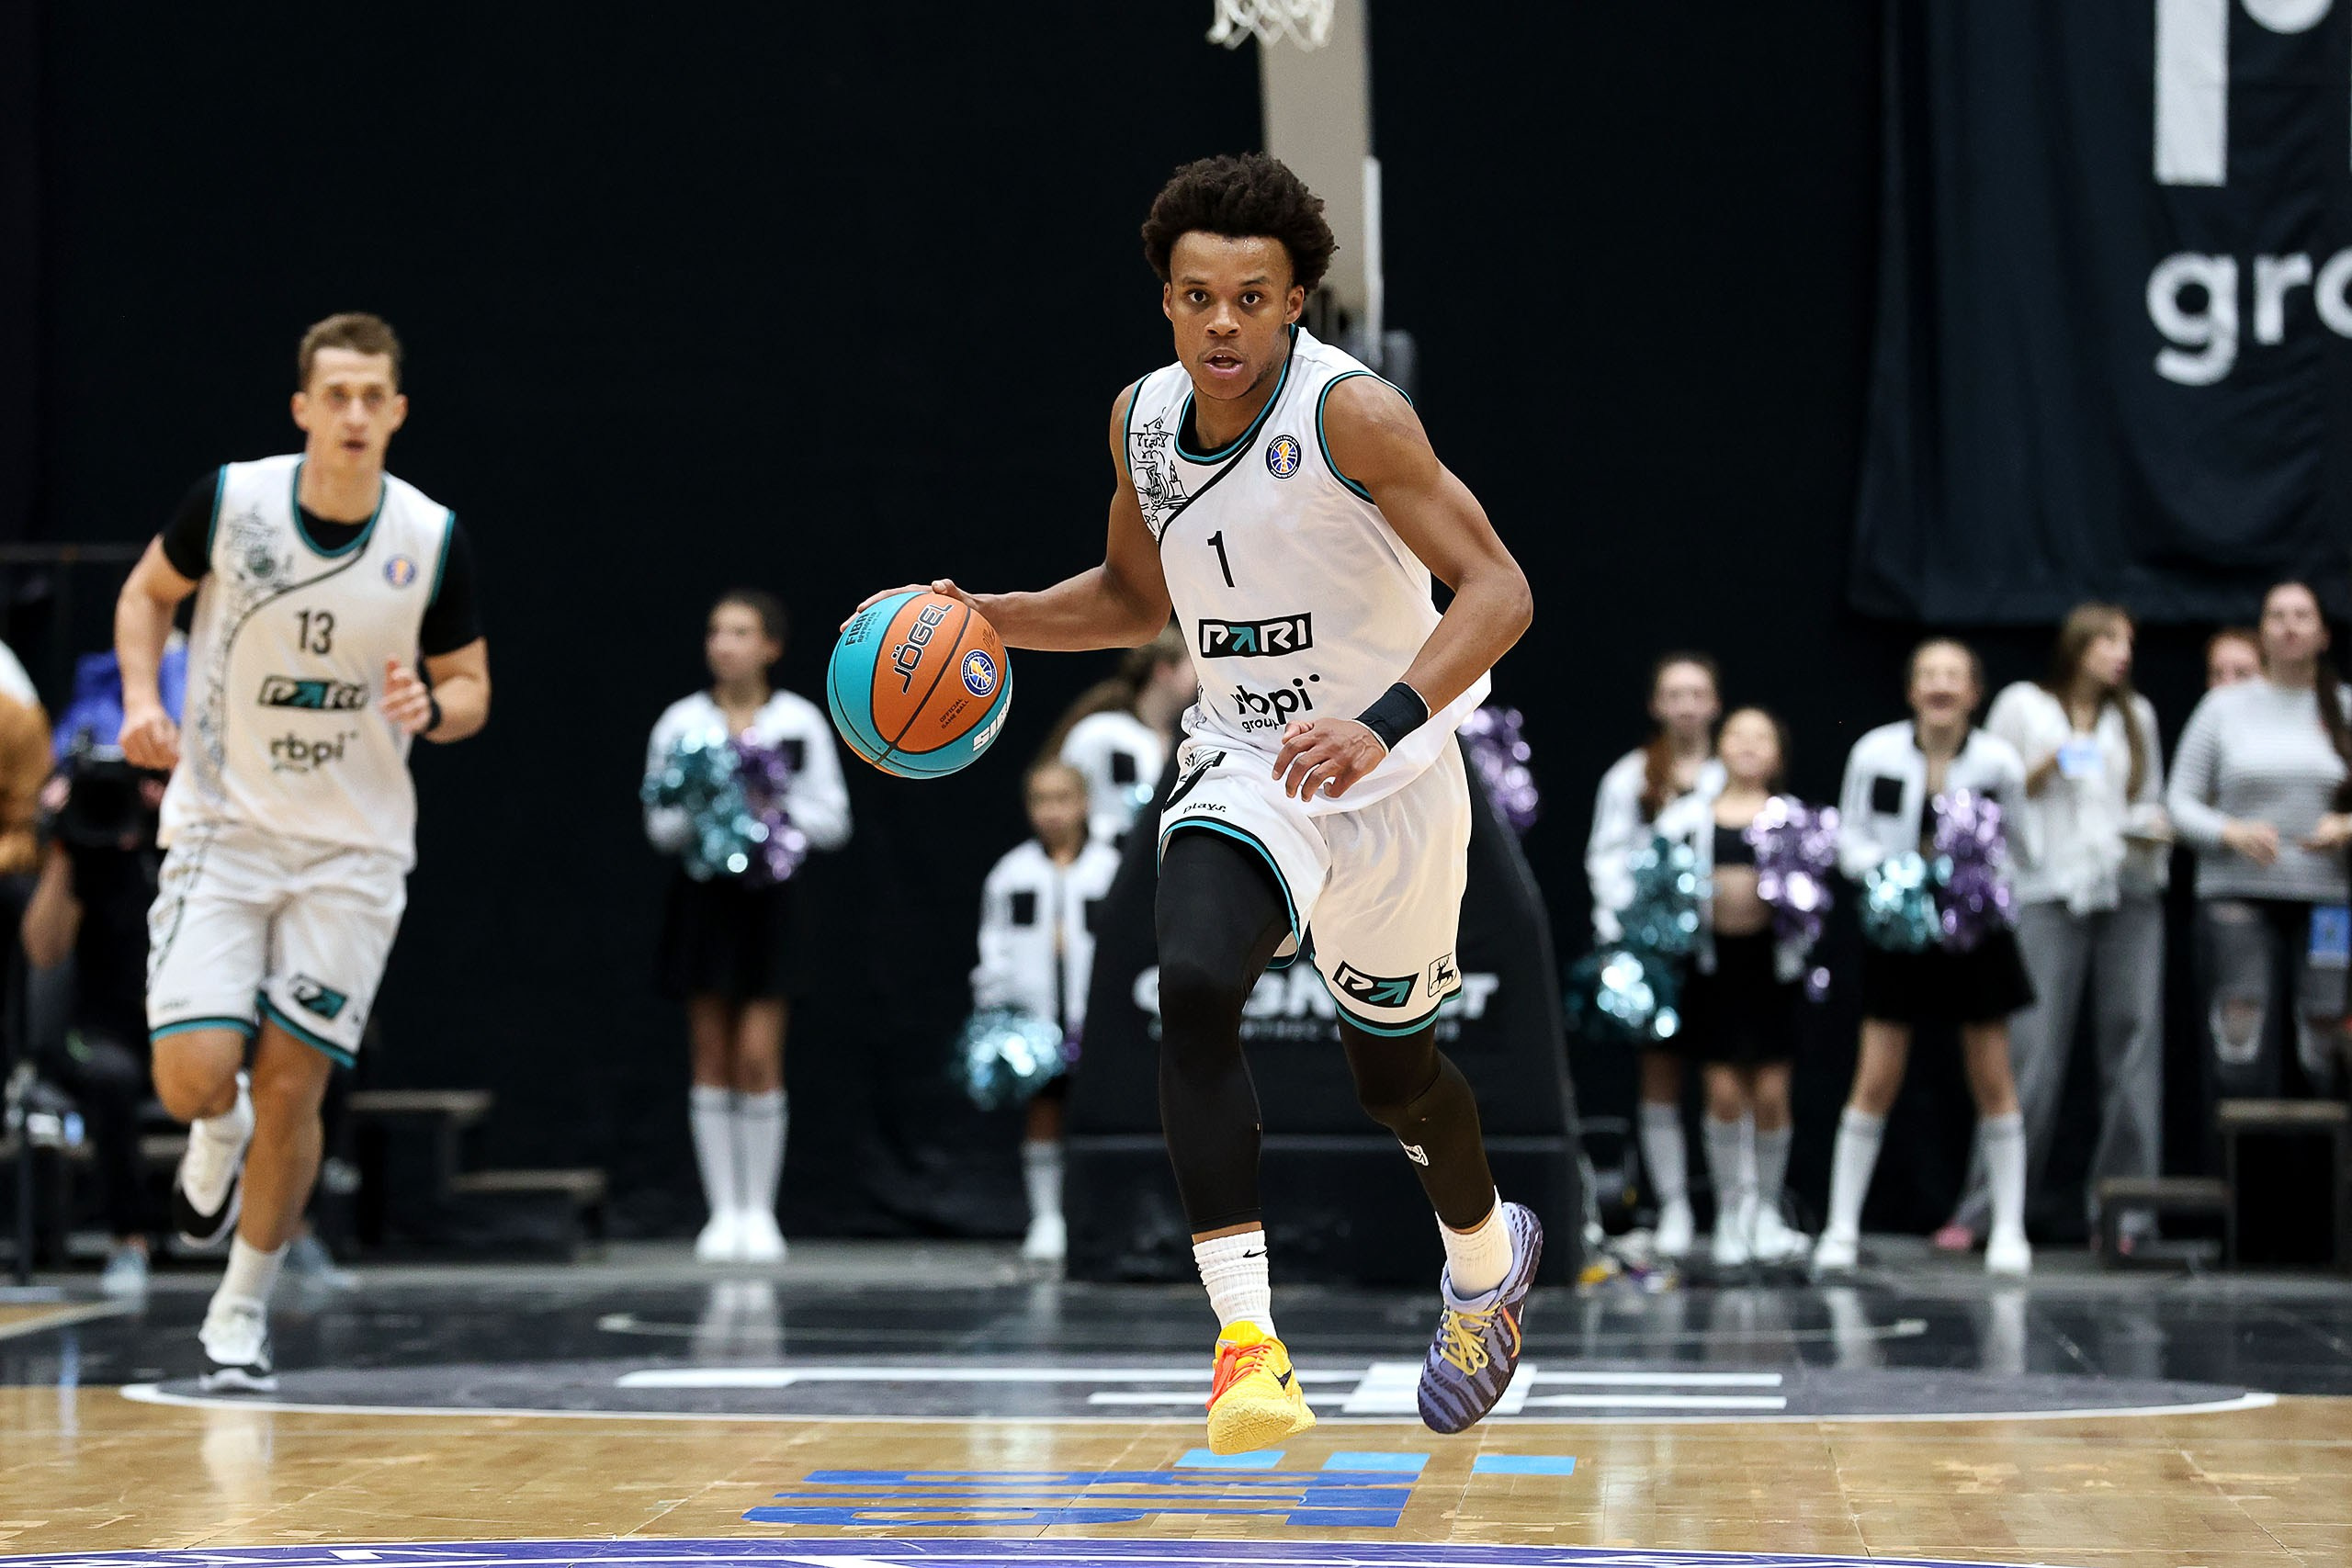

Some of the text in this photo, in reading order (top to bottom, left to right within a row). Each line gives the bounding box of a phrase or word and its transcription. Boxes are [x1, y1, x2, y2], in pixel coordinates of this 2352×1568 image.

[1207, 530, 1235, 588] 1
[297, 610, 335, 655] 13
[845, 613, 871, 646] FIBA
[891, 603, 954, 694] JÖGEL
[939, 698, 963, 723] OFFICIAL
[942, 700, 969, 729] GAME BALL
